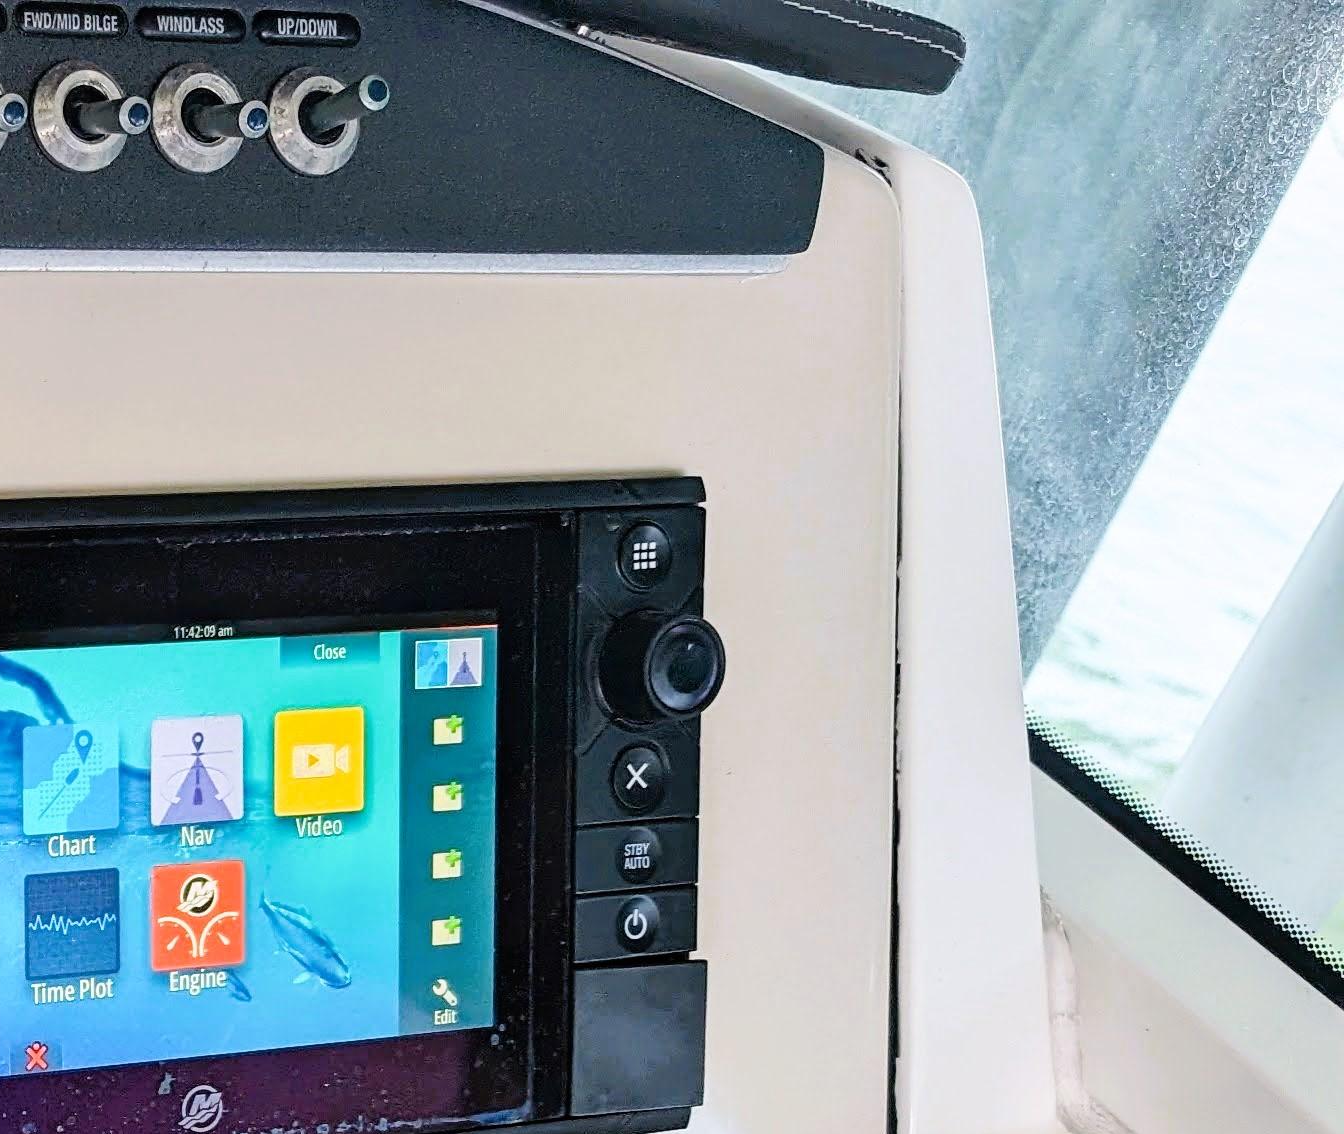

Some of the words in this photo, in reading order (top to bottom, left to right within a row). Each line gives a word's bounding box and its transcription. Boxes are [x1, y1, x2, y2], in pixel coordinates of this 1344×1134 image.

[23, 12, 81, 30] FWD/MID
[83, 13, 118, 32] BILGE
[157, 15, 224, 34] WINDLASS
[277, 17, 338, 37] UP/DOWN
[173, 625, 217, 639] 11:42:09
[218, 626, 233, 637] am
[313, 643, 347, 660] Close
[181, 826, 214, 847] Nav
[295, 815, 343, 838] Video
[48, 834, 96, 857] Chart
[624, 843, 650, 856] STBY
[624, 856, 650, 870] AUTO
[31, 982, 75, 1005] Time
[79, 978, 114, 1000] Plot
[169, 970, 227, 995] Engine
[434, 1009, 458, 1025] Edit
